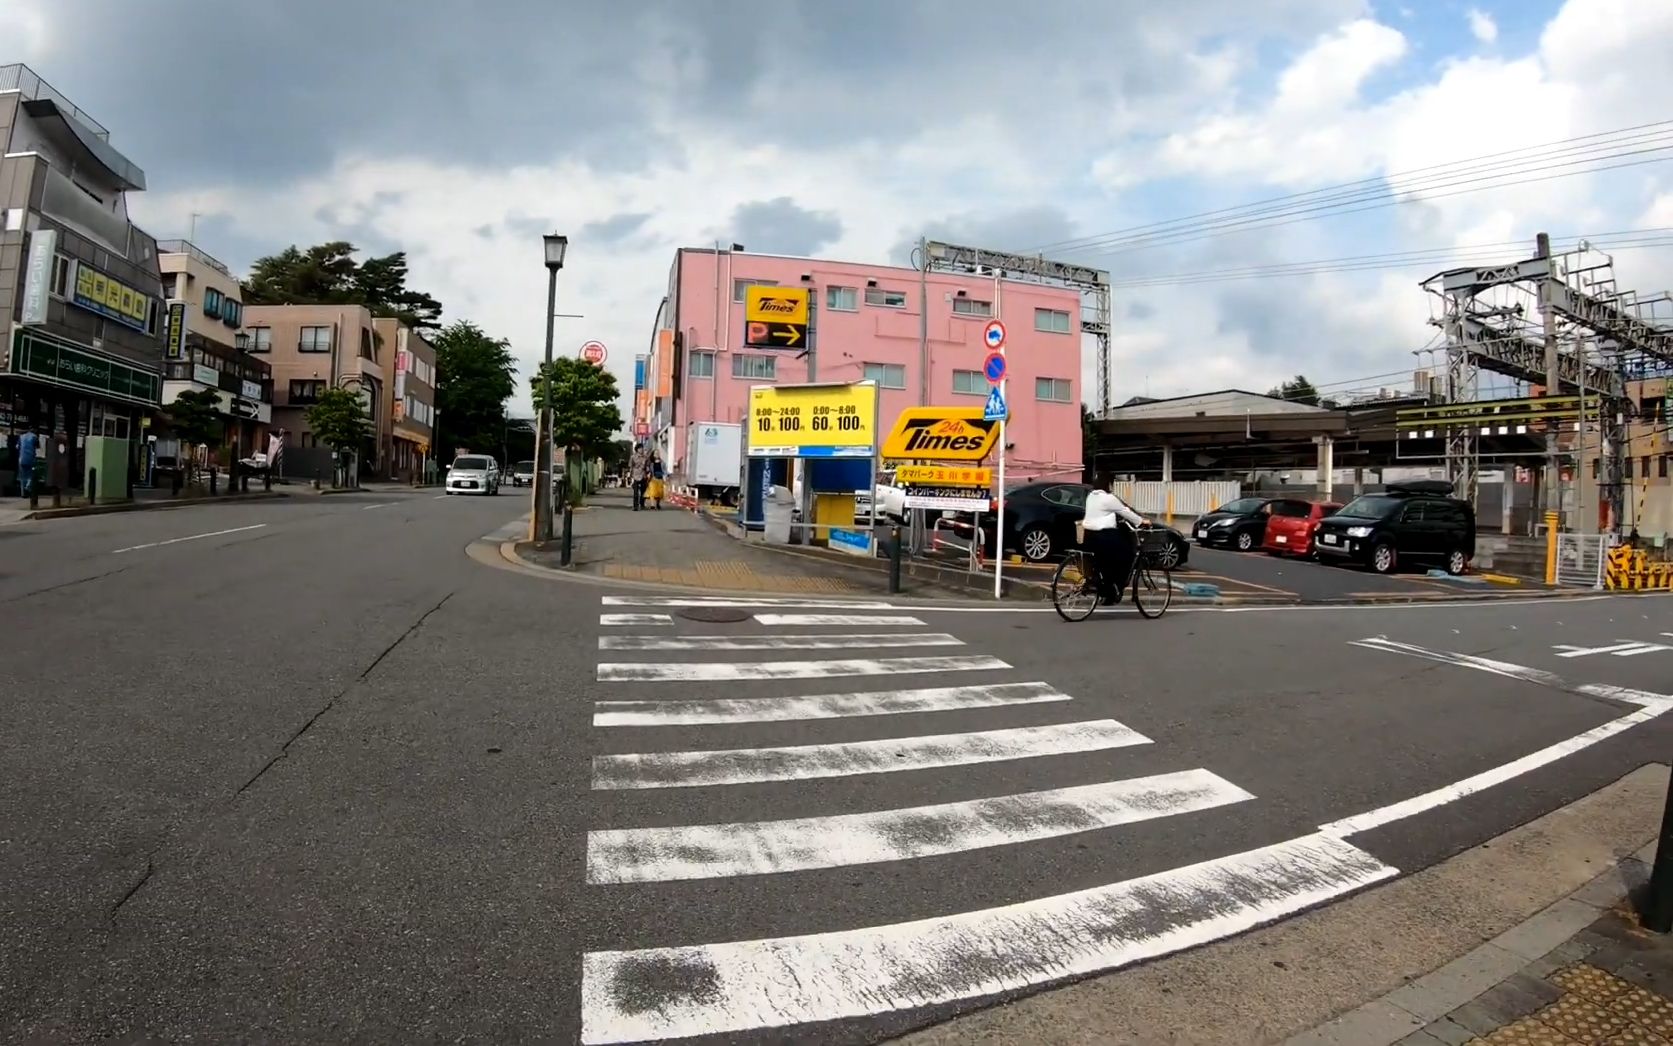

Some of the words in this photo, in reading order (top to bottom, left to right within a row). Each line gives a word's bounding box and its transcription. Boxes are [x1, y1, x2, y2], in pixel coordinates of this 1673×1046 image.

[759, 297, 799, 312] Times
[748, 322, 768, 343] P
[901, 420, 990, 451] Times
